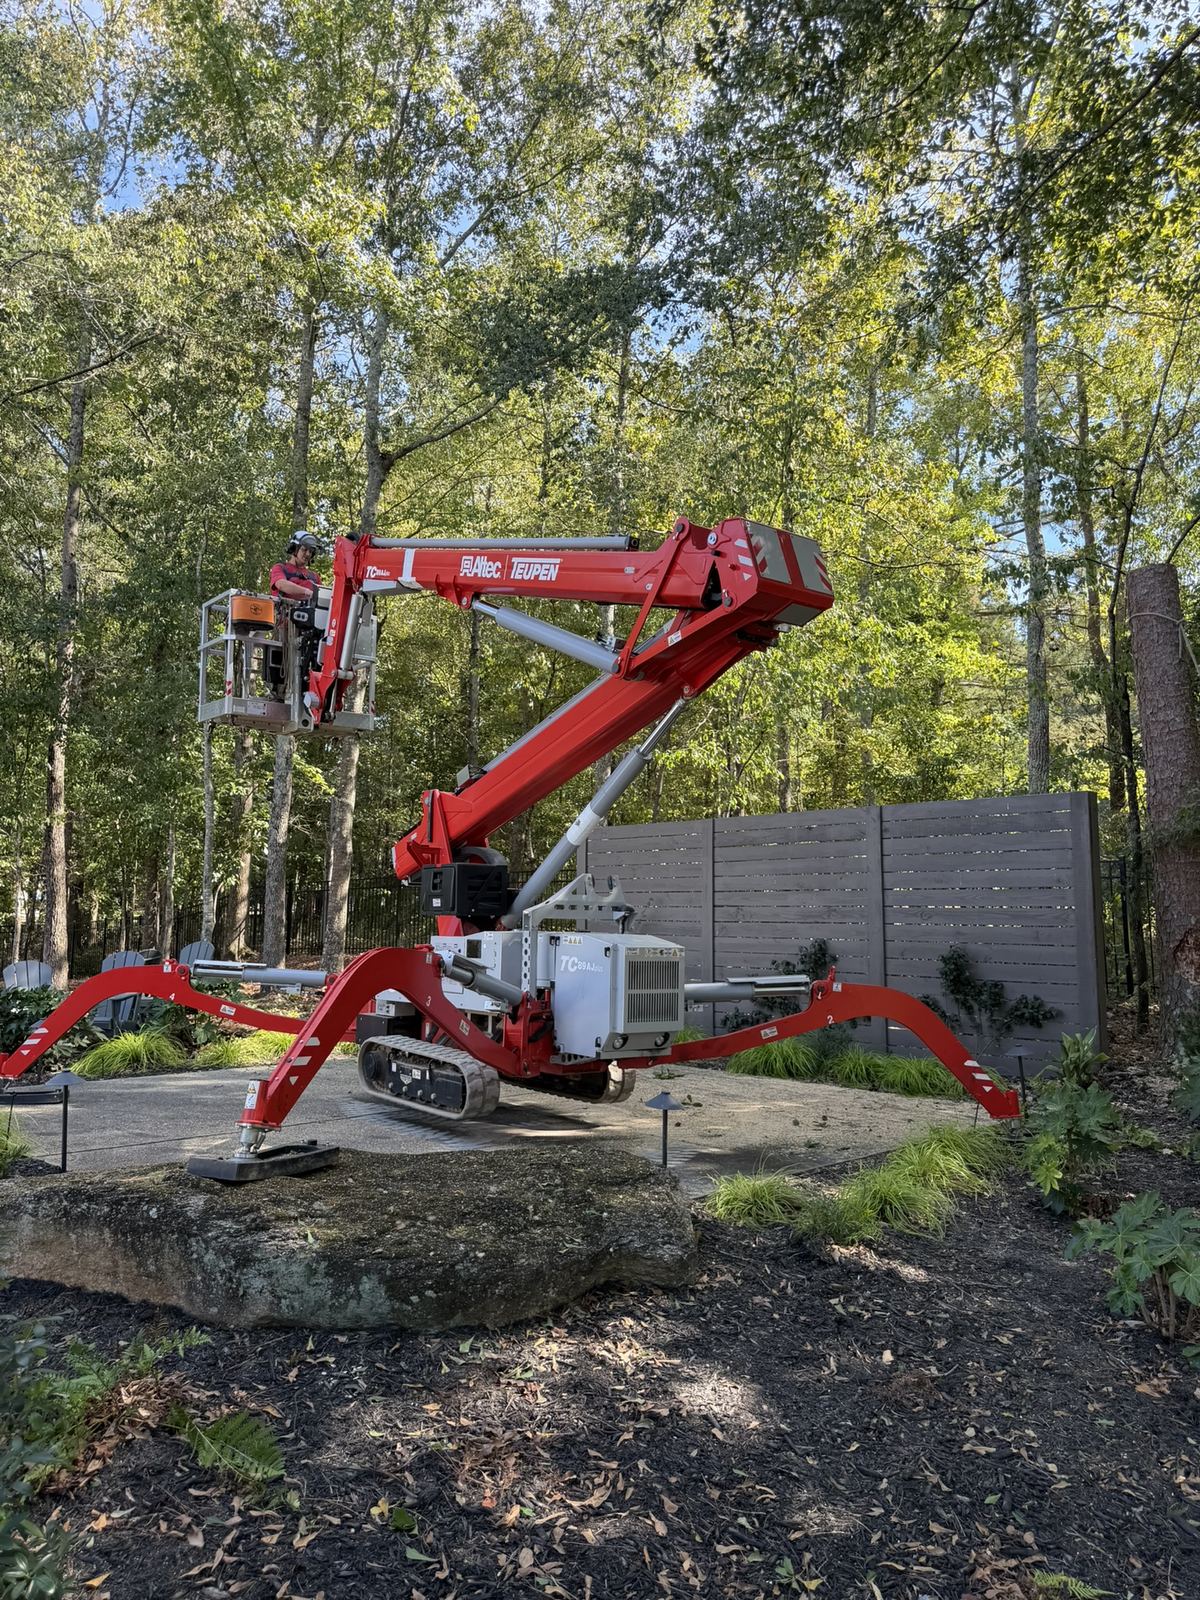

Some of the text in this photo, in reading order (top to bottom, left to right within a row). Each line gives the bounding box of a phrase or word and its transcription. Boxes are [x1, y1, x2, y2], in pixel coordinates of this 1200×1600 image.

[473, 556, 502, 578] Altec
[511, 557, 561, 581] TEUPEN
[425, 995, 432, 1007] 3
[827, 1014, 835, 1025] 2
